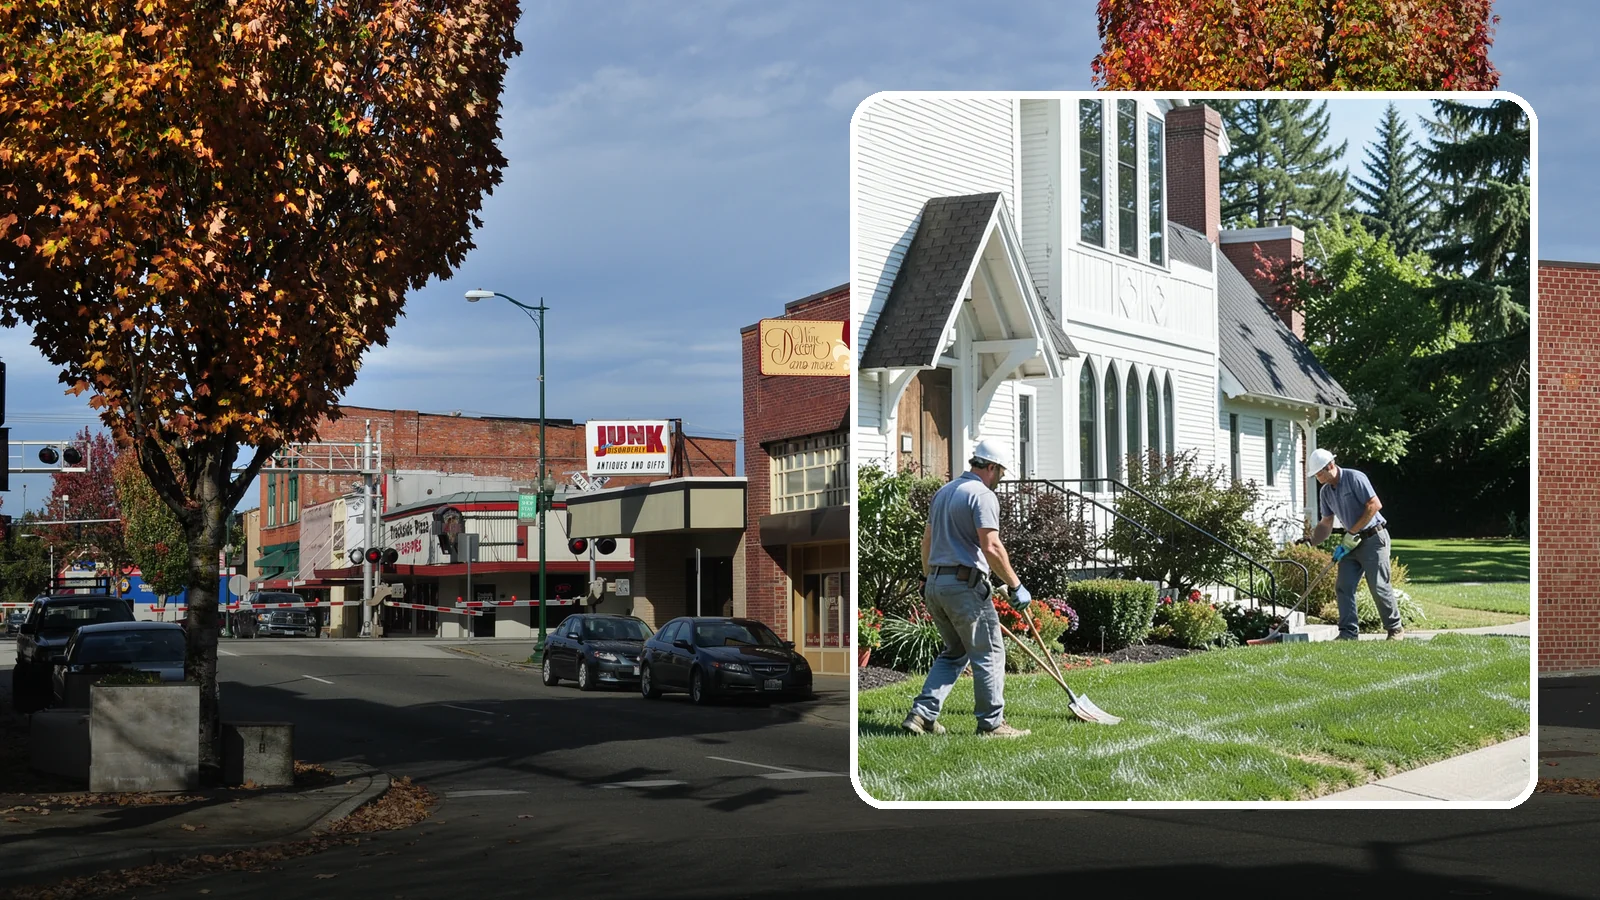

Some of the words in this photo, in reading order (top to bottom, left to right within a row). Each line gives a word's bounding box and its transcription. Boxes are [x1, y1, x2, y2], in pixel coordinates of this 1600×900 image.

[596, 425, 664, 457] JUNK
[607, 446, 645, 454] DISORDERLY
[597, 461, 628, 470] ANTIQUES
[631, 461, 644, 470] AND
[647, 460, 665, 470] GIFTS
